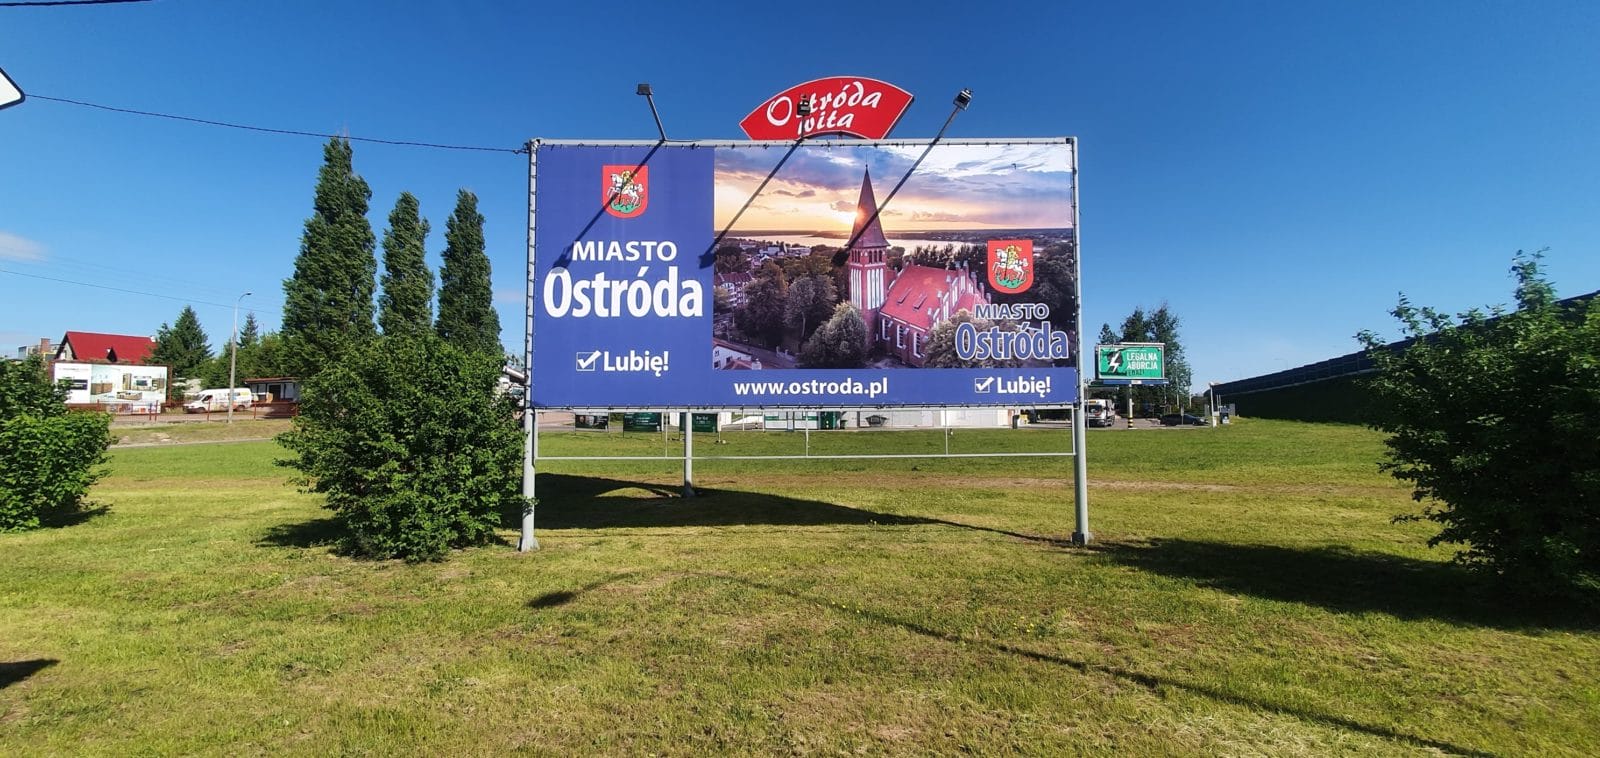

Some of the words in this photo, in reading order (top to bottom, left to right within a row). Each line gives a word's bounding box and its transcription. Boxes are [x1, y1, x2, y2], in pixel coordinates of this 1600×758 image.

[766, 81, 882, 127] Otróda
[572, 240, 678, 262] MIASTO
[543, 266, 703, 318] Ostróda
[975, 303, 1050, 320] MIASTO
[955, 321, 1069, 360] Ostróda
[603, 350, 669, 377] Lubię!
[1126, 352, 1158, 361] LEGALNA
[734, 377, 888, 398] www.ostroda.pl
[997, 376, 1051, 398] Lubię!
